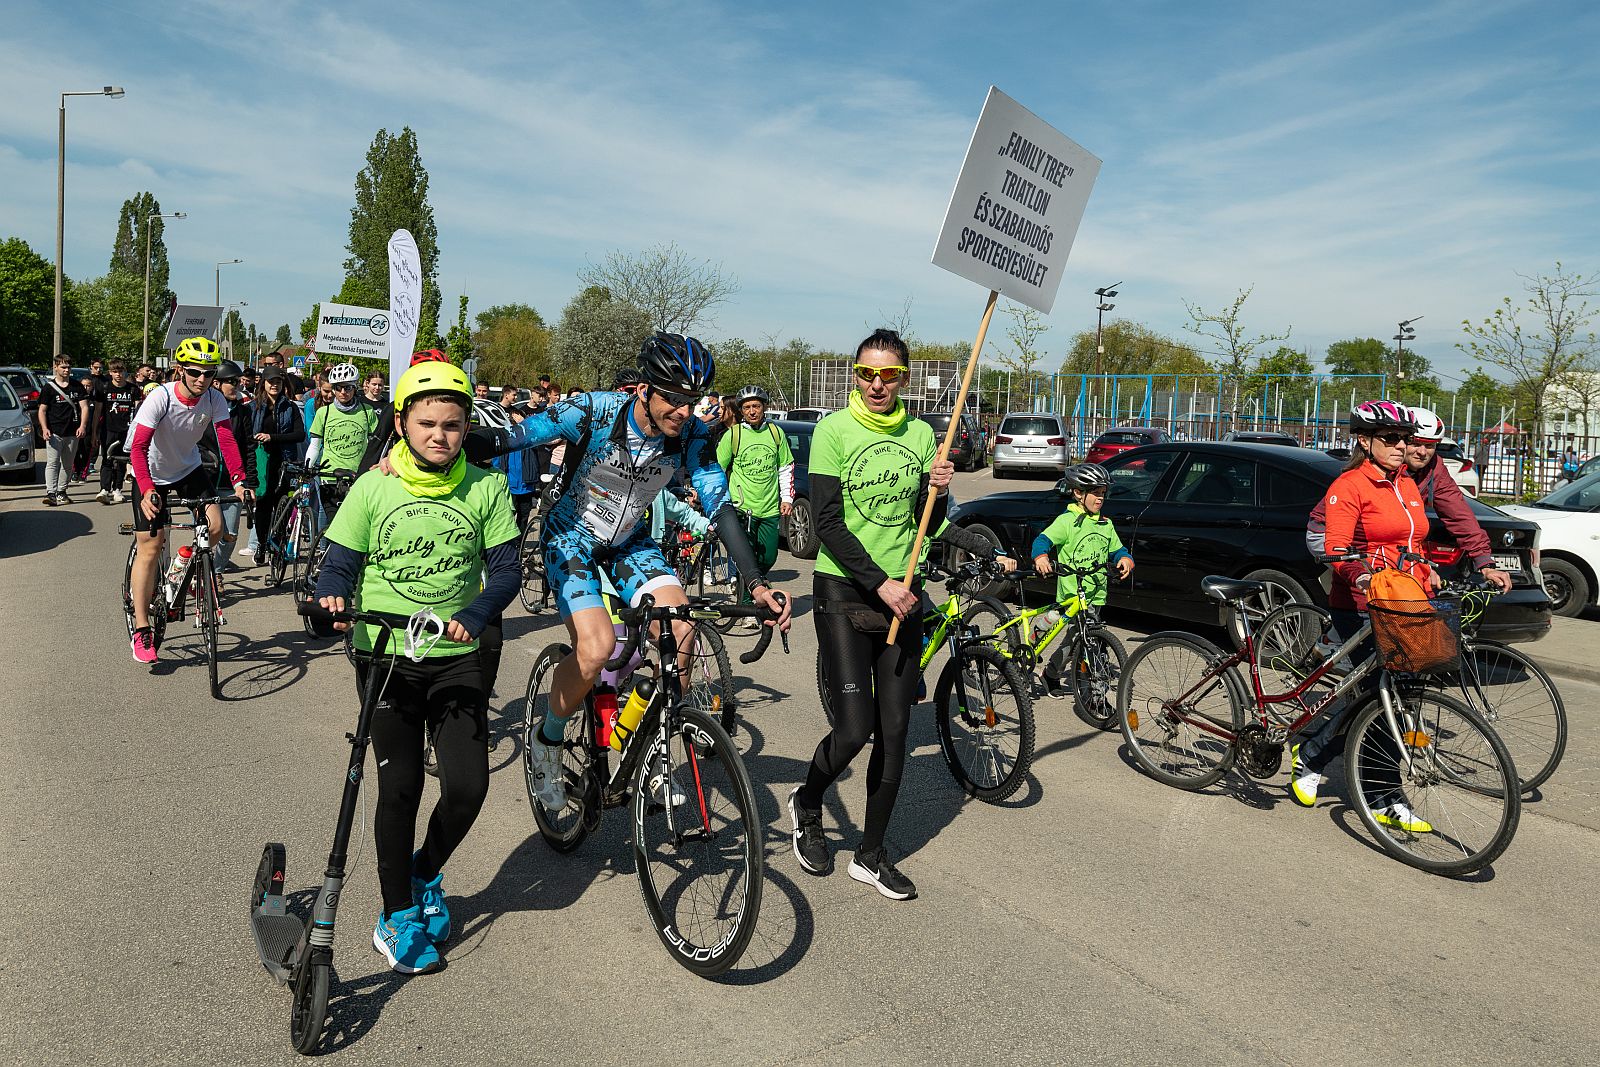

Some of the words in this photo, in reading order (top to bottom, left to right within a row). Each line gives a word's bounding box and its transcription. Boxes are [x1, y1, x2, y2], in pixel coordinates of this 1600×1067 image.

[1000, 169, 1052, 217] TRIATLON
[973, 191, 992, 223] ÉS
[988, 202, 1054, 255] SZABADIDŐS
[957, 226, 1049, 289] SPORTEGYESÜLET
[322, 316, 371, 327] MEGADANCE
[322, 333, 350, 342] Megadance
[350, 336, 386, 347] Székesfehérvári
[328, 343, 356, 353] Táncszínház
[356, 346, 378, 355] Egyesület
[855, 458, 869, 477] SWIM
[873, 446, 892, 455] BIKE
[898, 449, 914, 462] RUN
[840, 469, 900, 492] Family
[899, 462, 921, 477] Tre
[383, 520, 398, 545] SWIM
[406, 507, 429, 517] BIKE
[441, 511, 461, 527] RUN
[392, 555, 474, 581] Triatlon
